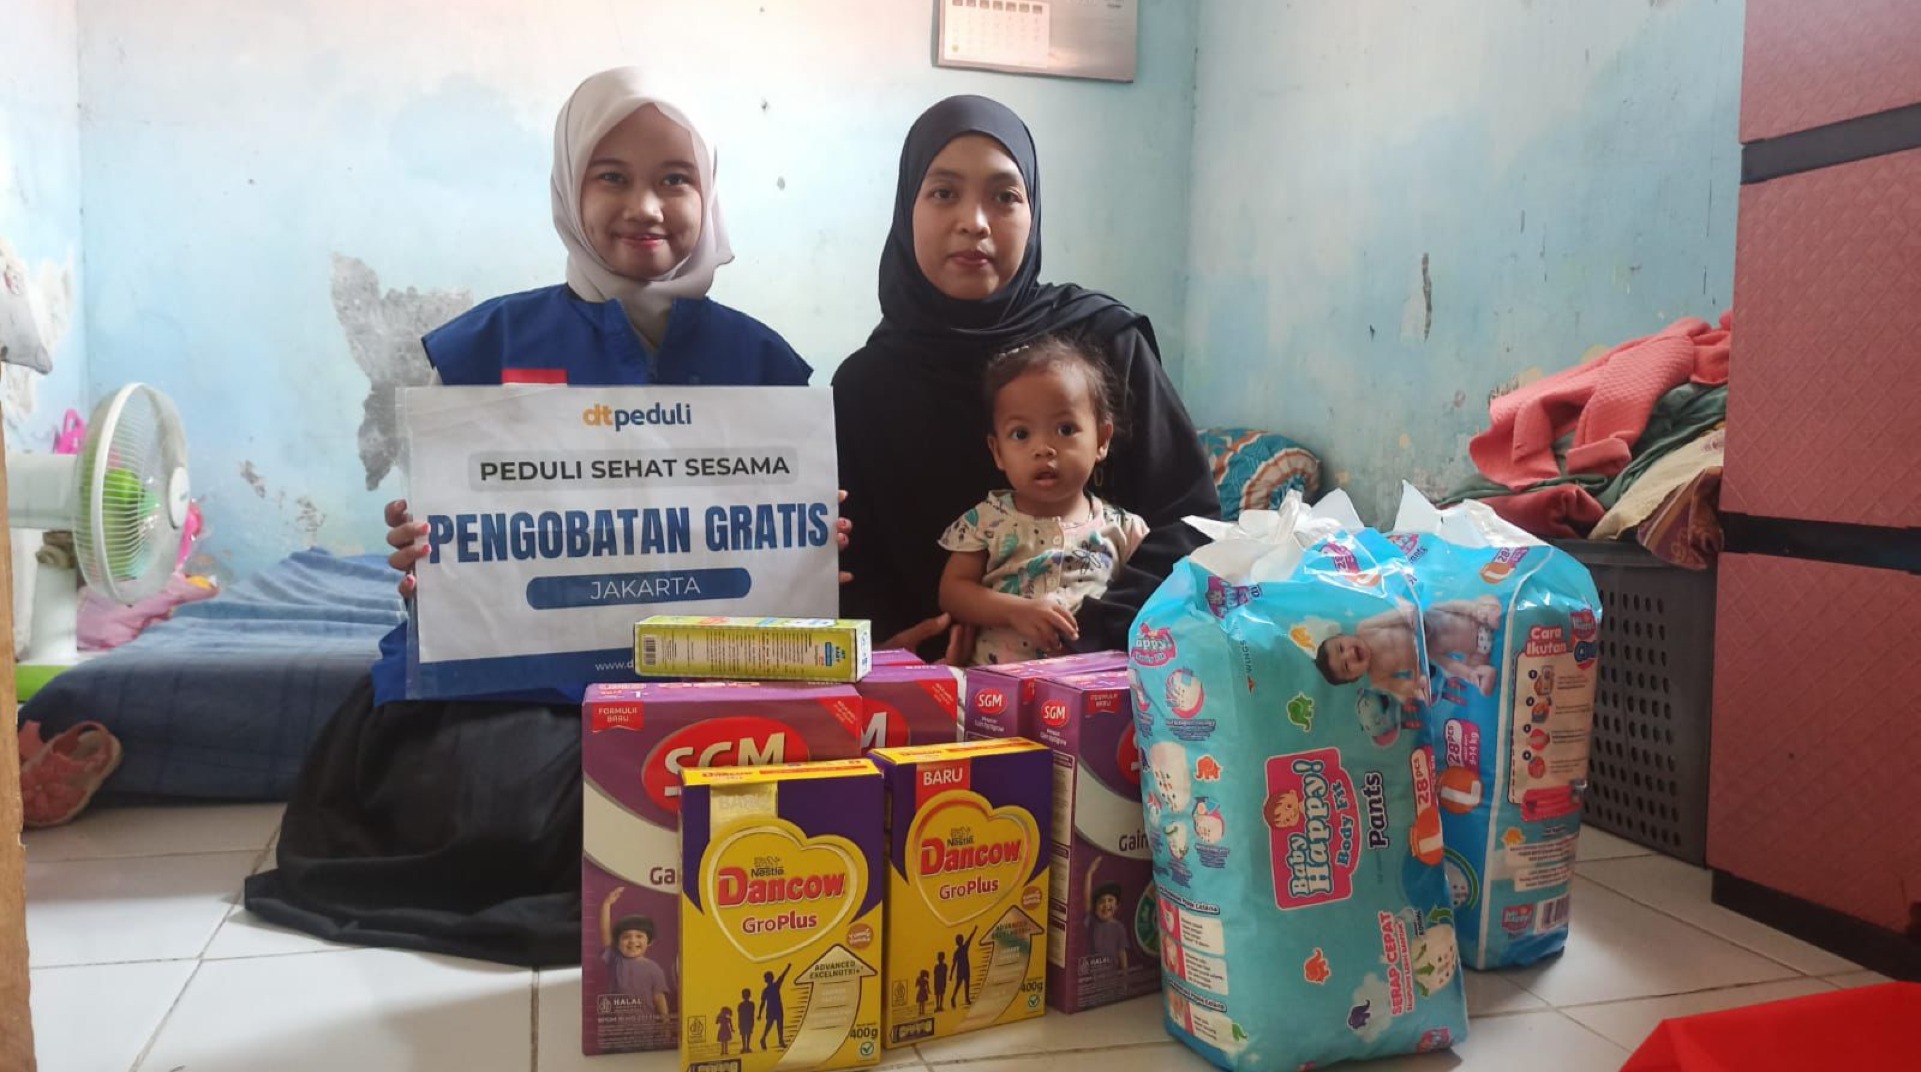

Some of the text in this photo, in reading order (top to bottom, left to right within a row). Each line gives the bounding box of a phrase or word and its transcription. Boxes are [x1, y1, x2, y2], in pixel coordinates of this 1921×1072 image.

[582, 402, 692, 432] dtpeduli
[480, 456, 791, 481] PEDULI SEHAT SESAMA
[427, 502, 829, 564] PENGOBATAN GRATIS
[590, 576, 701, 600] JAKARTA
[1531, 627, 1562, 640] Cara
[1526, 640, 1566, 655] Ikutan
[595, 660, 634, 672] www.d
[977, 693, 1003, 709] SGM
[1044, 704, 1066, 722] SGM
[1447, 743, 1460, 764] 28
[923, 768, 964, 787] BARU
[1414, 757, 1429, 805] 28 pcs
[1440, 780, 1481, 805] L
[1361, 770, 1390, 850] Pants
[1292, 759, 1335, 895] Happy!
[1332, 780, 1354, 866] Body Fit
[920, 837, 1022, 877] Dancow
[1286, 833, 1310, 898] Baby
[650, 866, 676, 886] Ga
[718, 867, 846, 907] Dancow
[939, 876, 999, 901] GroPlus
[742, 910, 818, 934] GroPlus
[814, 960, 856, 973] ADVANCED
[1380, 912, 1403, 1016] SERAP CEPAT
[613, 998, 643, 1006] HALAL
[850, 1026, 878, 1041] 400g
